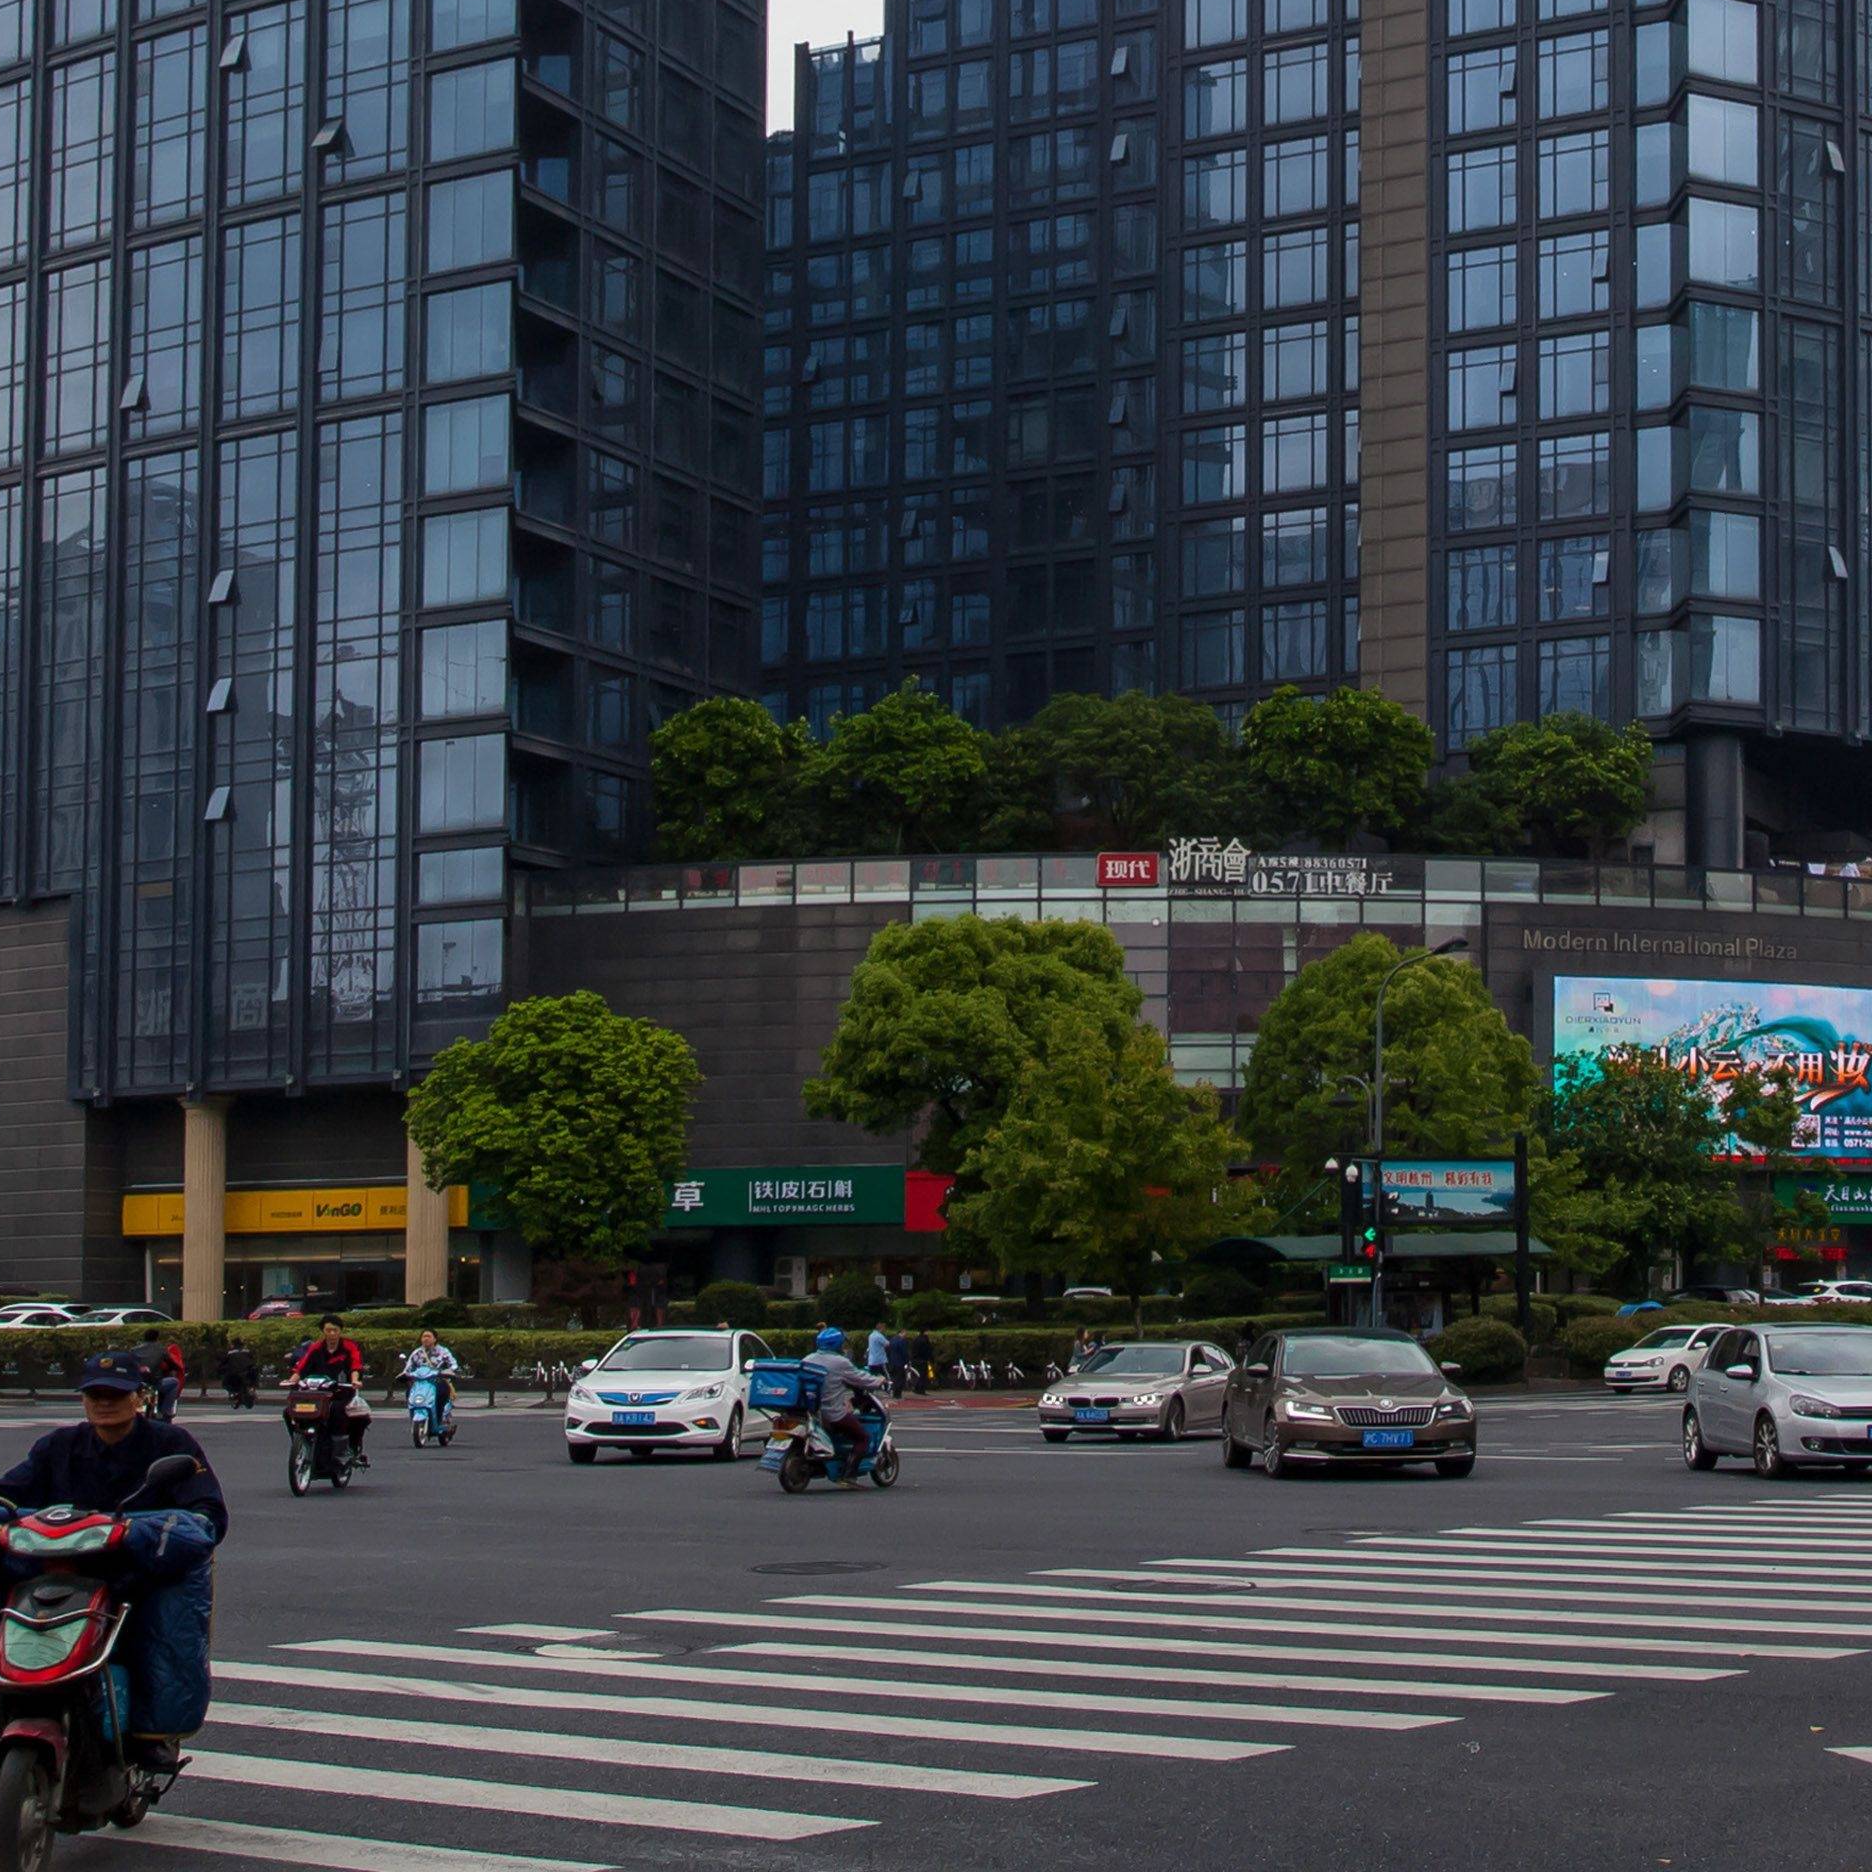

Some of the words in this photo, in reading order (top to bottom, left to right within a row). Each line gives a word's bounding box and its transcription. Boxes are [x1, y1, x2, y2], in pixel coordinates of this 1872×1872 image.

[1105, 859, 1151, 879] 现代
[1523, 929, 1608, 951] Modern
[1614, 932, 1740, 957] International
[1744, 938, 1798, 960] Plaza
